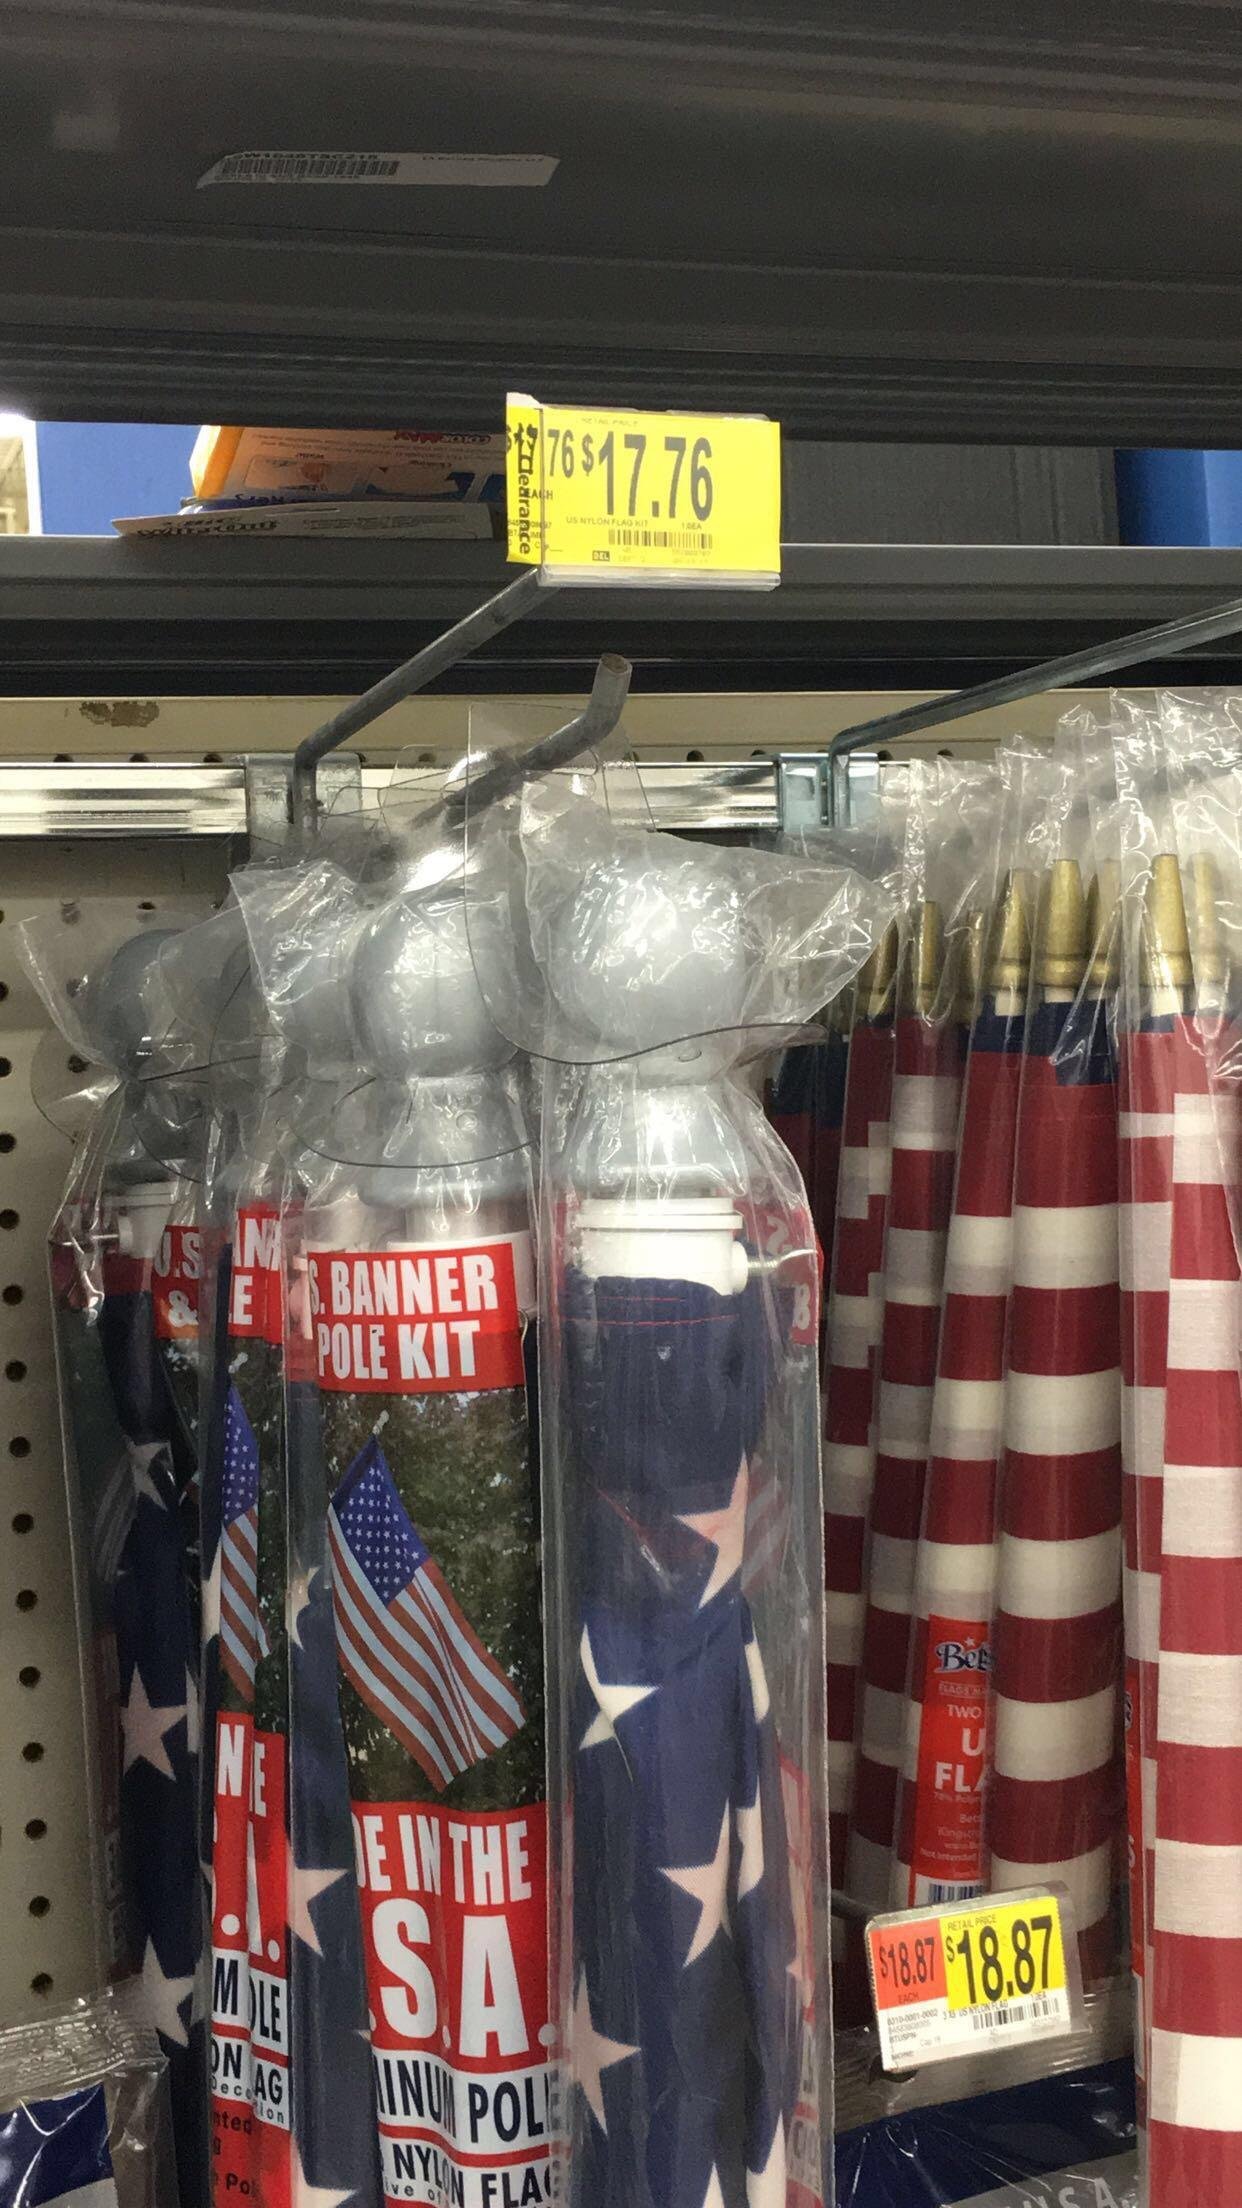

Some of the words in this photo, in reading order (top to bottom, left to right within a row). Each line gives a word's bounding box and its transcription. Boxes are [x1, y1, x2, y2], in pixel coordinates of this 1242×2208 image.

[582, 431, 713, 521] $17.76
[580, 517, 610, 526] NYLON
[331, 1255, 498, 1316] BANNER
[317, 1322, 388, 1380] POLE
[397, 1320, 480, 1380] KIT
[947, 1704, 982, 1719] TWO
[398, 1815, 441, 1896] IN
[448, 1820, 532, 1905] THE
[947, 1915, 974, 1930] RETAIL
[975, 1914, 997, 1925] PRICE
[879, 1937, 936, 1988] $18.87
[946, 1915, 1053, 2004] $18.87
[468, 2073, 550, 2143] POL
